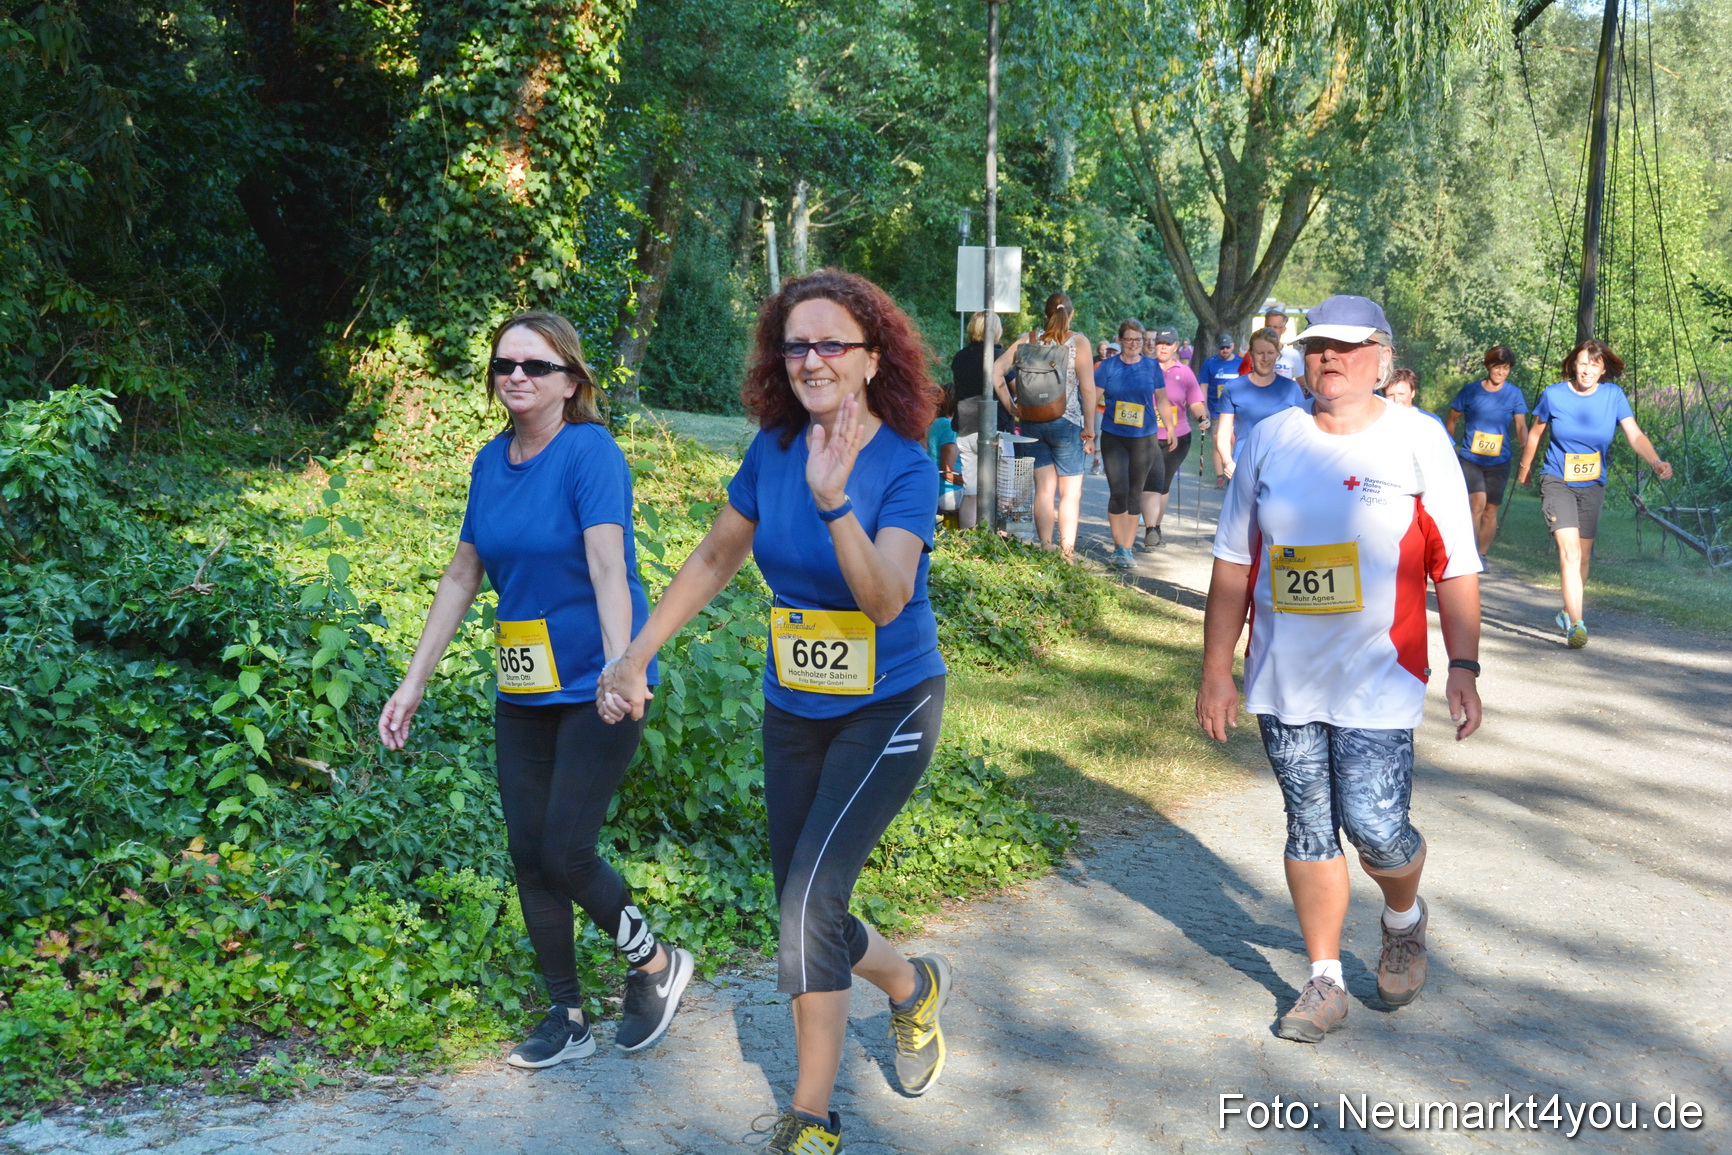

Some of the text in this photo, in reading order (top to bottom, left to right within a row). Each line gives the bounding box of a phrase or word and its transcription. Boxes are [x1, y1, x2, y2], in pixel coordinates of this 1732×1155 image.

[1121, 410, 1138, 419] 654
[1479, 440, 1496, 450] 670
[1574, 463, 1595, 474] 657
[1364, 477, 1402, 489] Bayerisches
[1360, 494, 1388, 506] Agnes
[1286, 569, 1335, 594] 261
[1312, 595, 1335, 603] Agnes
[500, 647, 535, 673] 665
[792, 640, 849, 670] 662
[788, 668, 858, 680] Hochholzer Sabine
